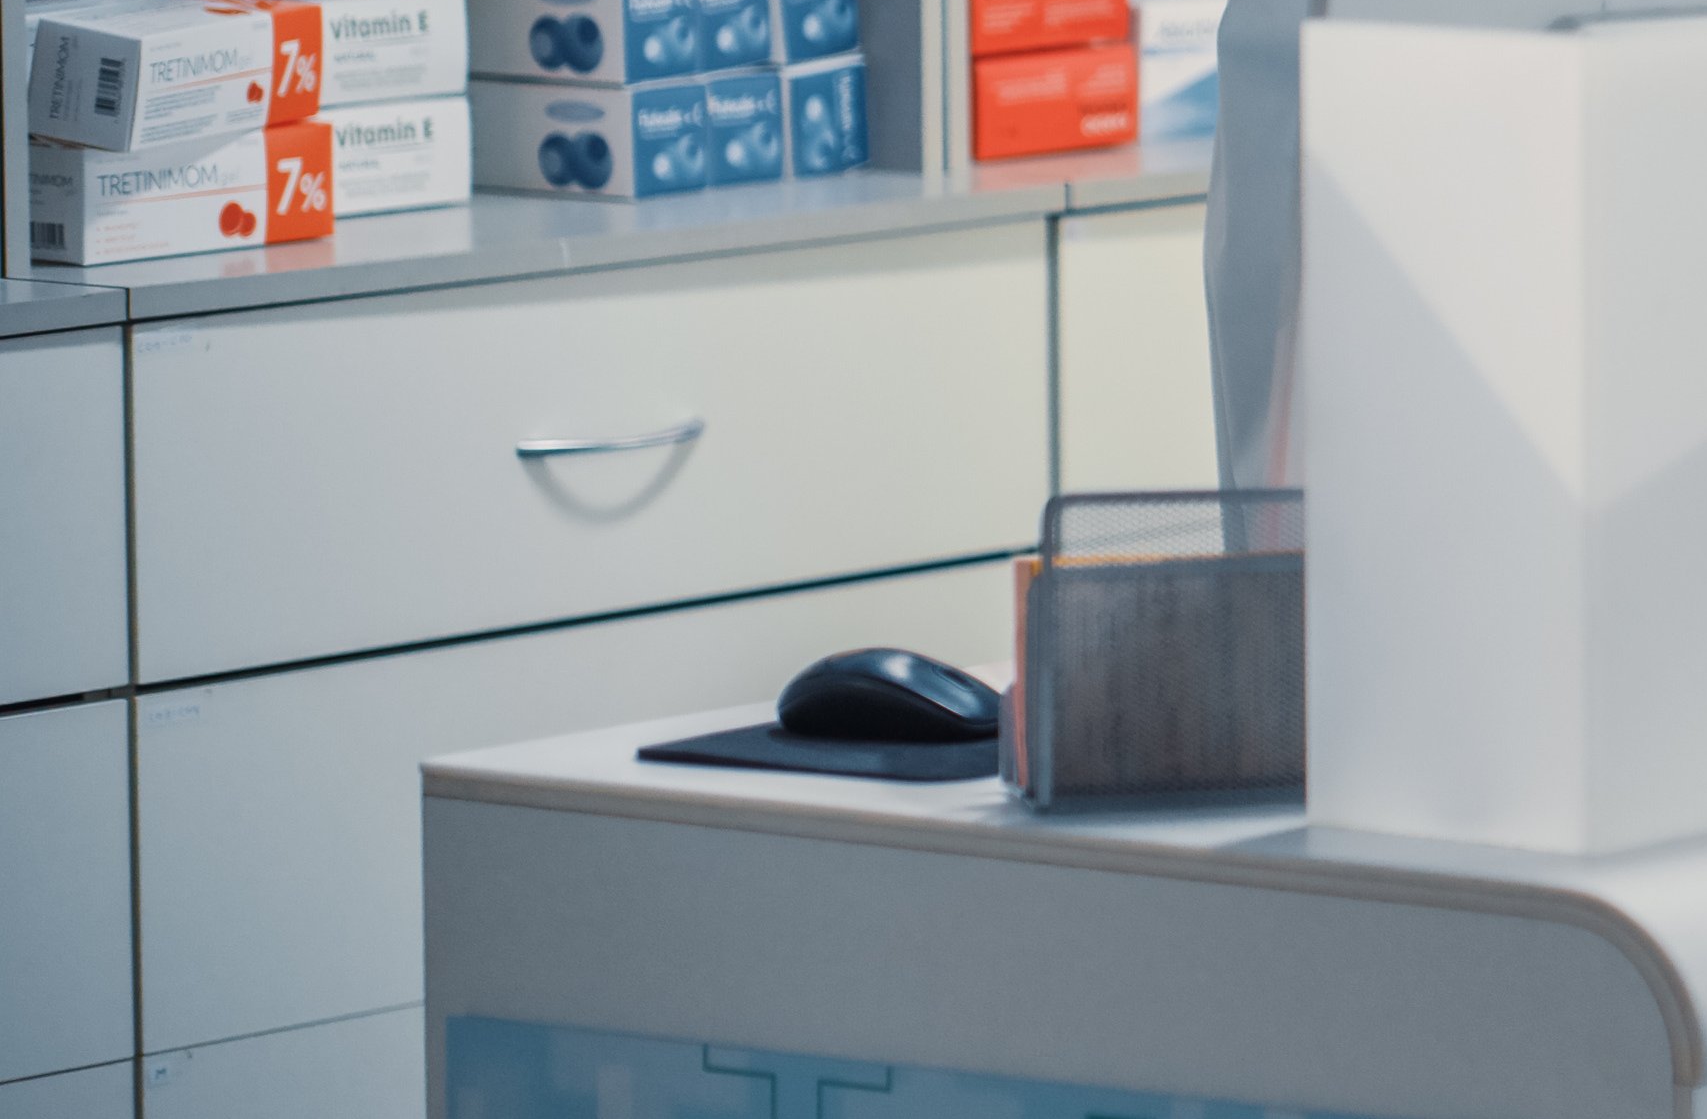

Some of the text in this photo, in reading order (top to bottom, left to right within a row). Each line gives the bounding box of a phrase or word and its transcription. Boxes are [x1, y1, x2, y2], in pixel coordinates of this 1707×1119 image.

[330, 9, 429, 40] Vitamin E
[49, 36, 71, 119] TRETINIMOM
[149, 48, 238, 83] TRETINIMOM
[277, 39, 317, 98] 7%
[336, 116, 433, 148] Vitamin E
[97, 163, 219, 197] TRETINIMOM
[276, 156, 327, 216] 7%
